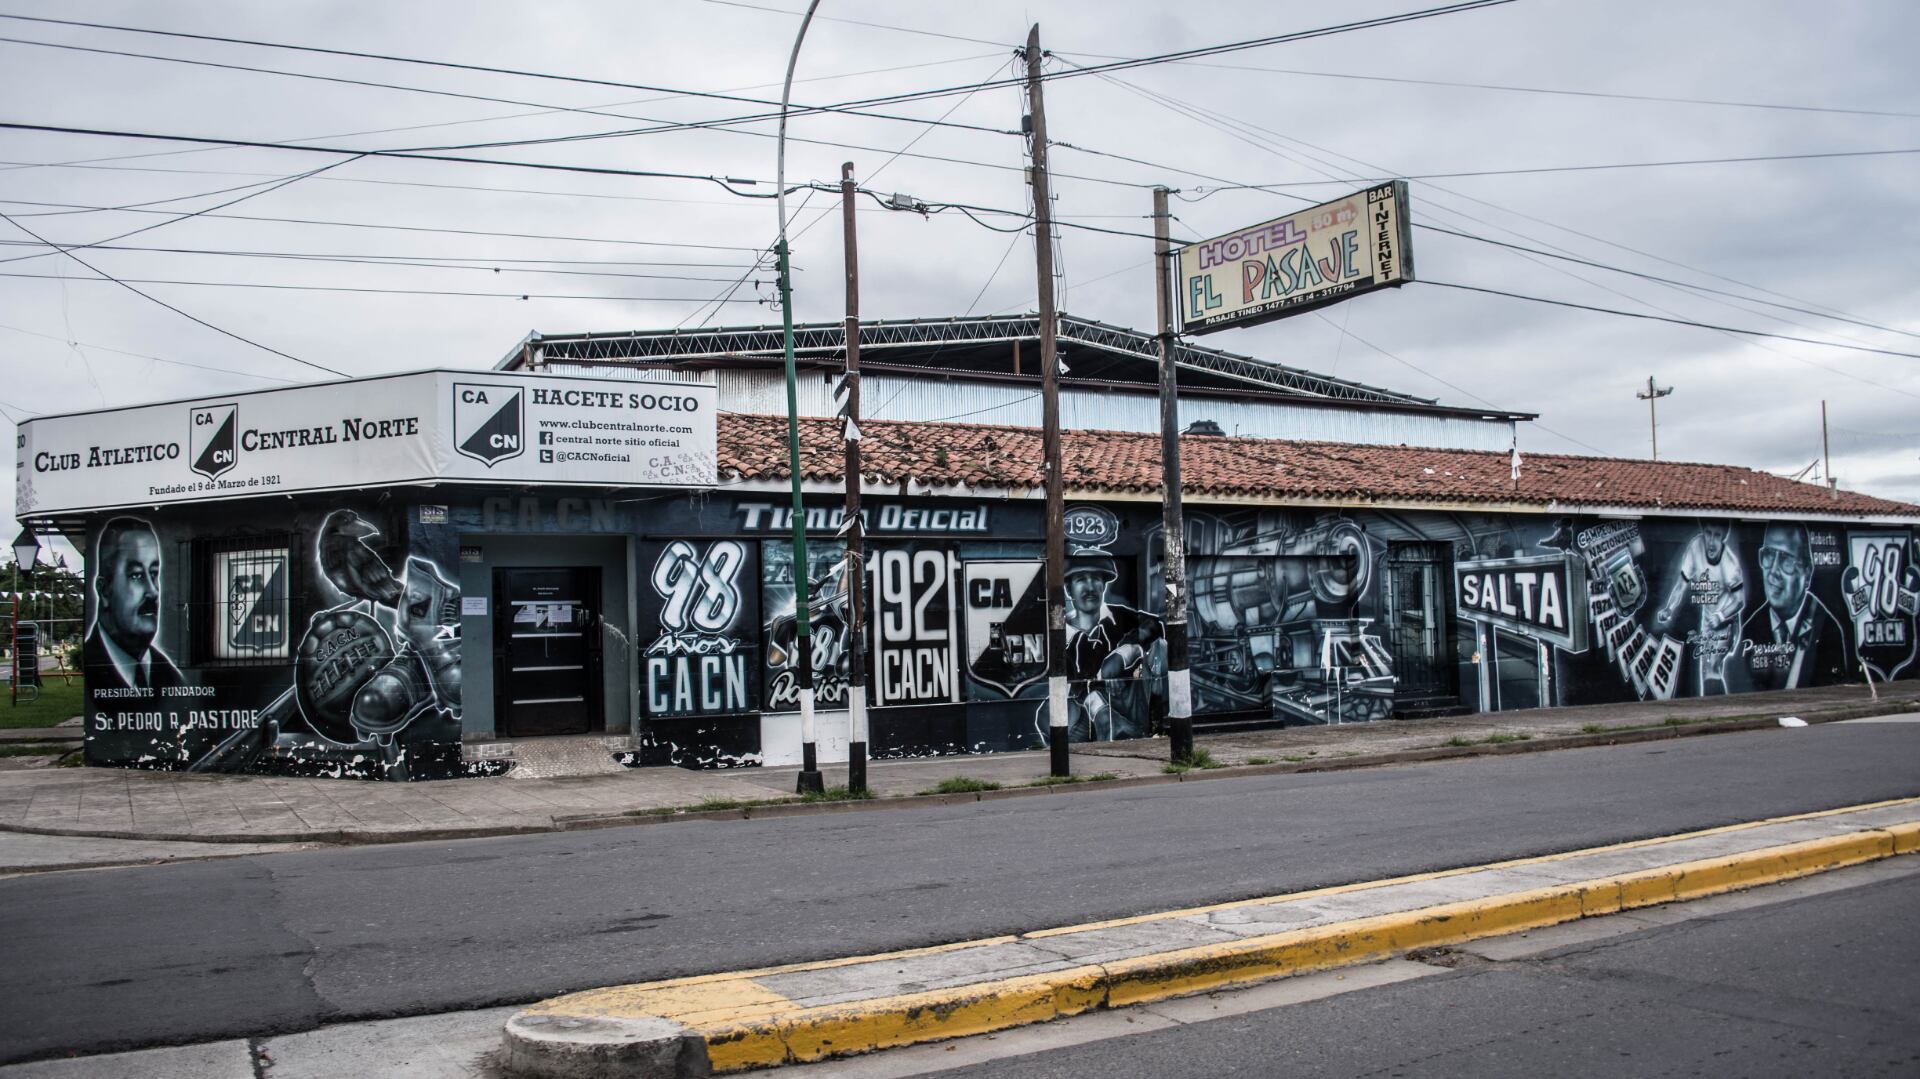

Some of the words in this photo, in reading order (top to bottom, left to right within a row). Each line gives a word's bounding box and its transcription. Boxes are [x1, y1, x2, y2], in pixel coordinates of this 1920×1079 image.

[1369, 186, 1392, 203] BAR
[1200, 220, 1307, 270] HOTEL
[1375, 202, 1392, 280] INTERNET
[1189, 275, 1223, 318] EL
[1242, 230, 1360, 305] PASAJE
[1205, 312, 1236, 325] PASAJE
[1237, 305, 1263, 318] TINEO
[1265, 299, 1285, 310] 1477
[1292, 294, 1304, 303] TE
[1322, 281, 1356, 297] 317794
[462, 390, 488, 404] CA
[532, 388, 623, 409] HACETE
[629, 393, 699, 412] SOCIO
[196, 412, 213, 425] CA
[539, 419, 693, 434] www.clubcentralnorte.com
[490, 433, 518, 449] CN
[556, 435, 592, 444] central
[595, 437, 622, 446] norte
[624, 437, 646, 446] sitio
[649, 438, 680, 448] oficial
[213, 449, 233, 463] CN
[556, 451, 631, 463] @CACNoficial
[149, 483, 186, 496] Fundado
[188, 482, 196, 492] el
[198, 482, 203, 490] 9
[205, 481, 215, 490] de
[217, 479, 246, 489] Marzo
[248, 477, 259, 486] de
[261, 475, 281, 485] 1921
[1068, 516, 1106, 535] 1923
[1813, 552, 1841, 565] ROMERO
[652, 540, 744, 634] 98
[1863, 543, 1902, 619] 98
[969, 577, 1013, 609] CA
[1463, 571, 1564, 628] SALTA
[1691, 593, 1718, 604] nuclear
[1865, 621, 1904, 643] CACN
[1004, 634, 1045, 663] CN
[884, 648, 950, 700] CACN
[1654, 645, 1677, 693] 1985
[94, 687, 154, 698] PRESIDENTE
[162, 686, 216, 697] FUNDADOR
[648, 655, 746, 712] CACN
[769, 671, 849, 710] Paión
[118, 711, 162, 731] PEDRO
[189, 709, 259, 729] PASTORE
